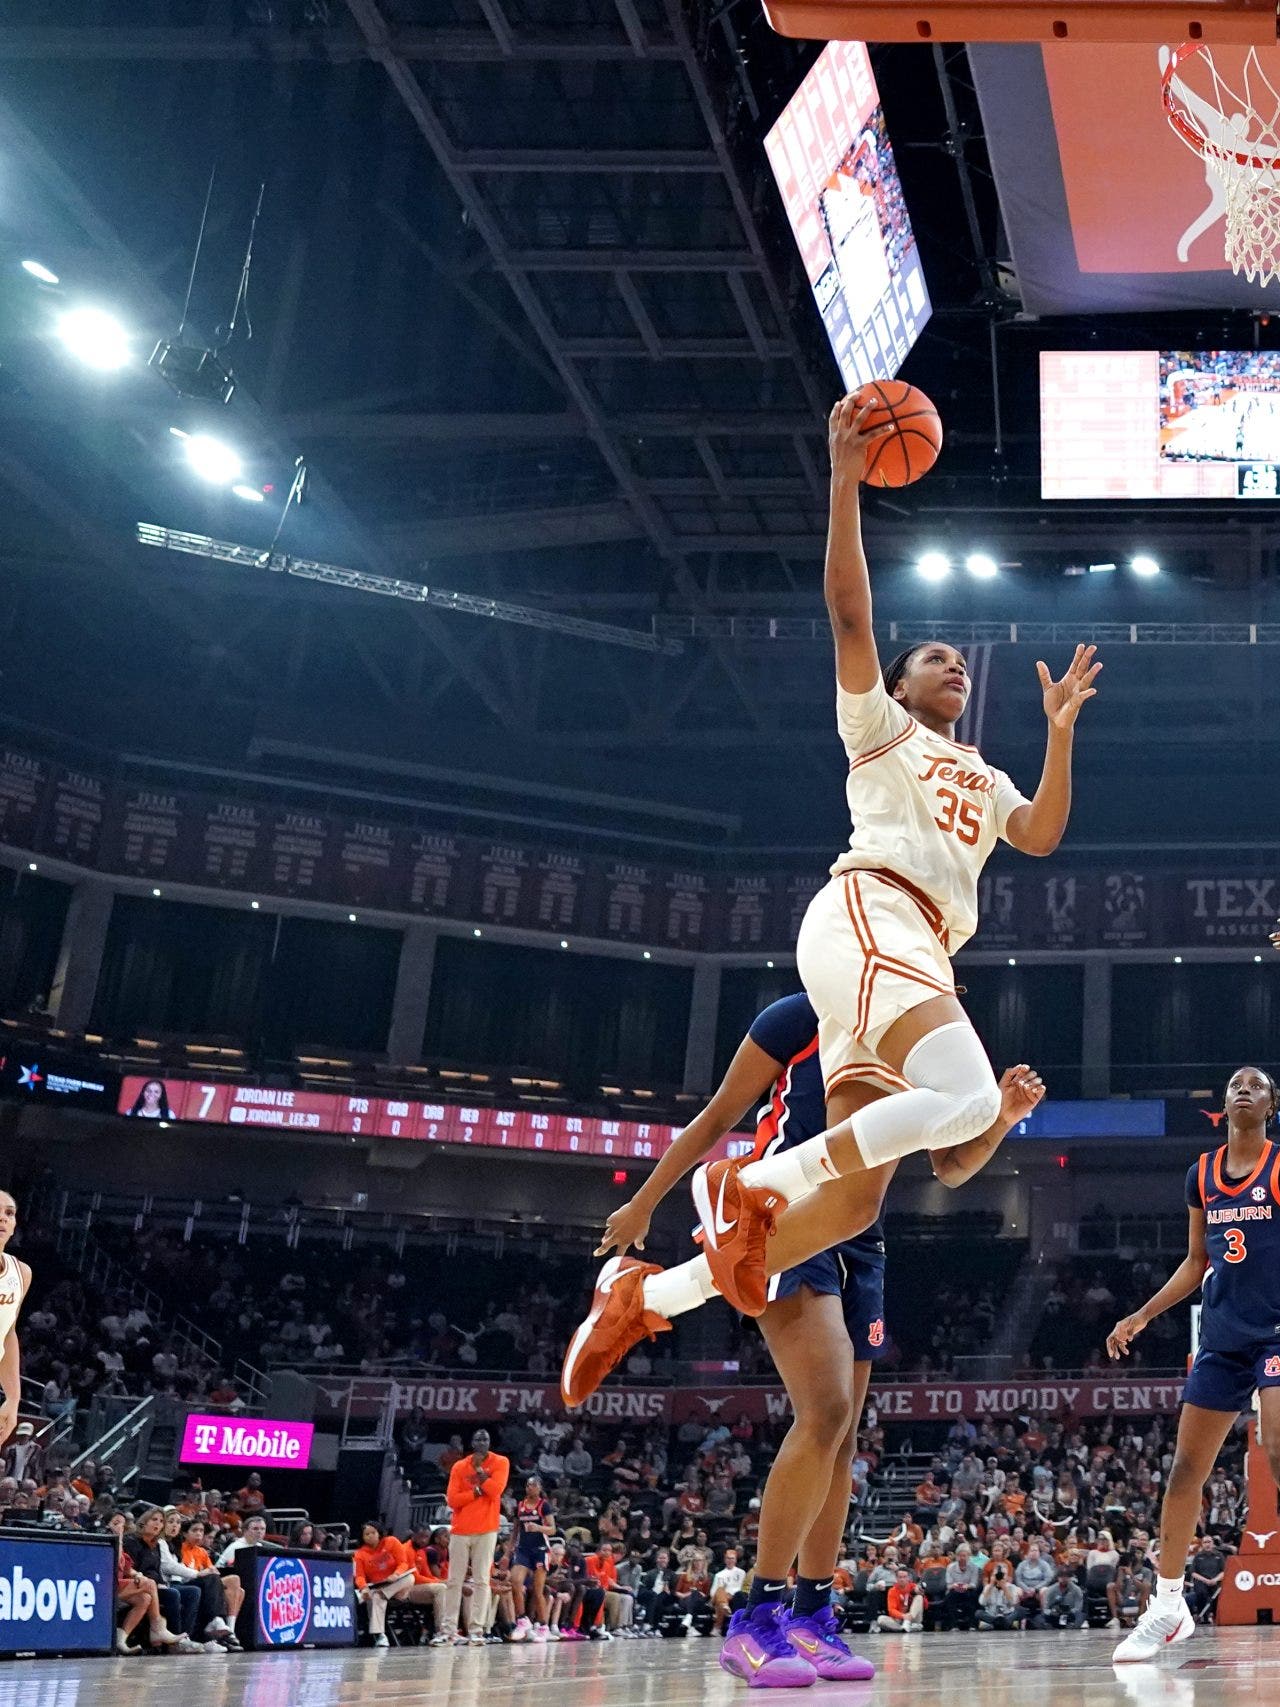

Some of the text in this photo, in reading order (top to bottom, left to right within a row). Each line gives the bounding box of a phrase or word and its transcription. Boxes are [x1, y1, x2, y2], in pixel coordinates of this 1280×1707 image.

[918, 754, 996, 799] Texas
[934, 787, 983, 847] 35
[200, 1086, 216, 1119] 7
[234, 1087, 295, 1107] JORDAN LEE
[348, 1098, 369, 1114] PTS
[496, 1110, 516, 1127] AST
[531, 1114, 548, 1130] FLS
[566, 1117, 583, 1133] STL
[352, 1117, 361, 1132] 3
[391, 1120, 400, 1136] 0
[428, 1124, 437, 1139] 2
[464, 1127, 472, 1142] 2
[501, 1130, 507, 1145] 1
[534, 1132, 543, 1148] 0
[570, 1135, 578, 1151] 0
[605, 1138, 613, 1154] 0
[1207, 1205, 1272, 1224] AUBURN
[1223, 1228, 1247, 1264] 3
[397, 1385, 478, 1412] HOOK
[565, 1391, 666, 1417] ORNS
[925, 1390, 962, 1413] TO
[975, 1387, 1080, 1413] MOODY
[1092, 1384, 1184, 1410] CENT
[220, 1426, 300, 1459] Mobile
[267, 1571, 304, 1602] Jersey
[313, 1571, 346, 1599] a sub
[313, 1599, 351, 1628] above
